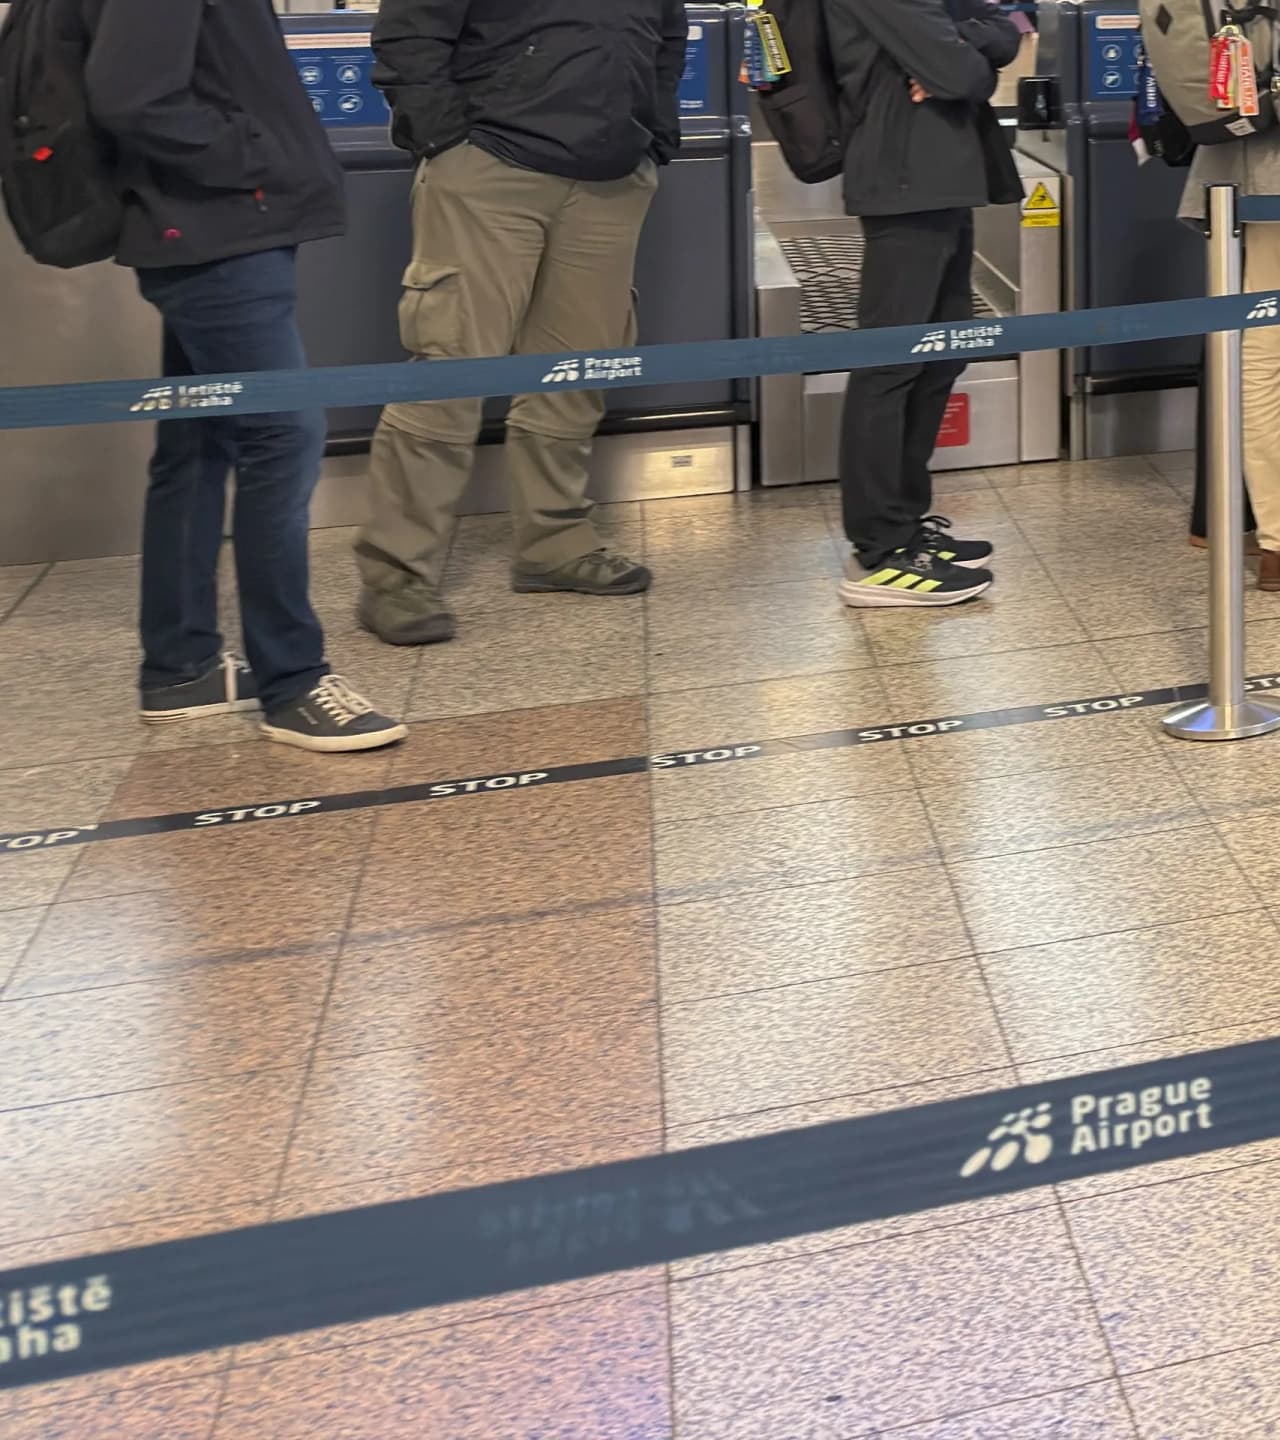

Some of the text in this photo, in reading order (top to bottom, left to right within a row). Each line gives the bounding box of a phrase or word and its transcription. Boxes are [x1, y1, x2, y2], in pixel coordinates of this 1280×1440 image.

[950, 338, 995, 350] Praha
[583, 367, 642, 381] Airport
[584, 357, 642, 370] Prague
[1044, 695, 1143, 717] STOP
[859, 720, 963, 740] STOP
[652, 746, 761, 768] STOP
[430, 772, 549, 797] STOP
[195, 800, 320, 827] STOP
[0, 830, 80, 850] OP
[1069, 1077, 1212, 1125] Prague
[1069, 1103, 1212, 1156] Airport
